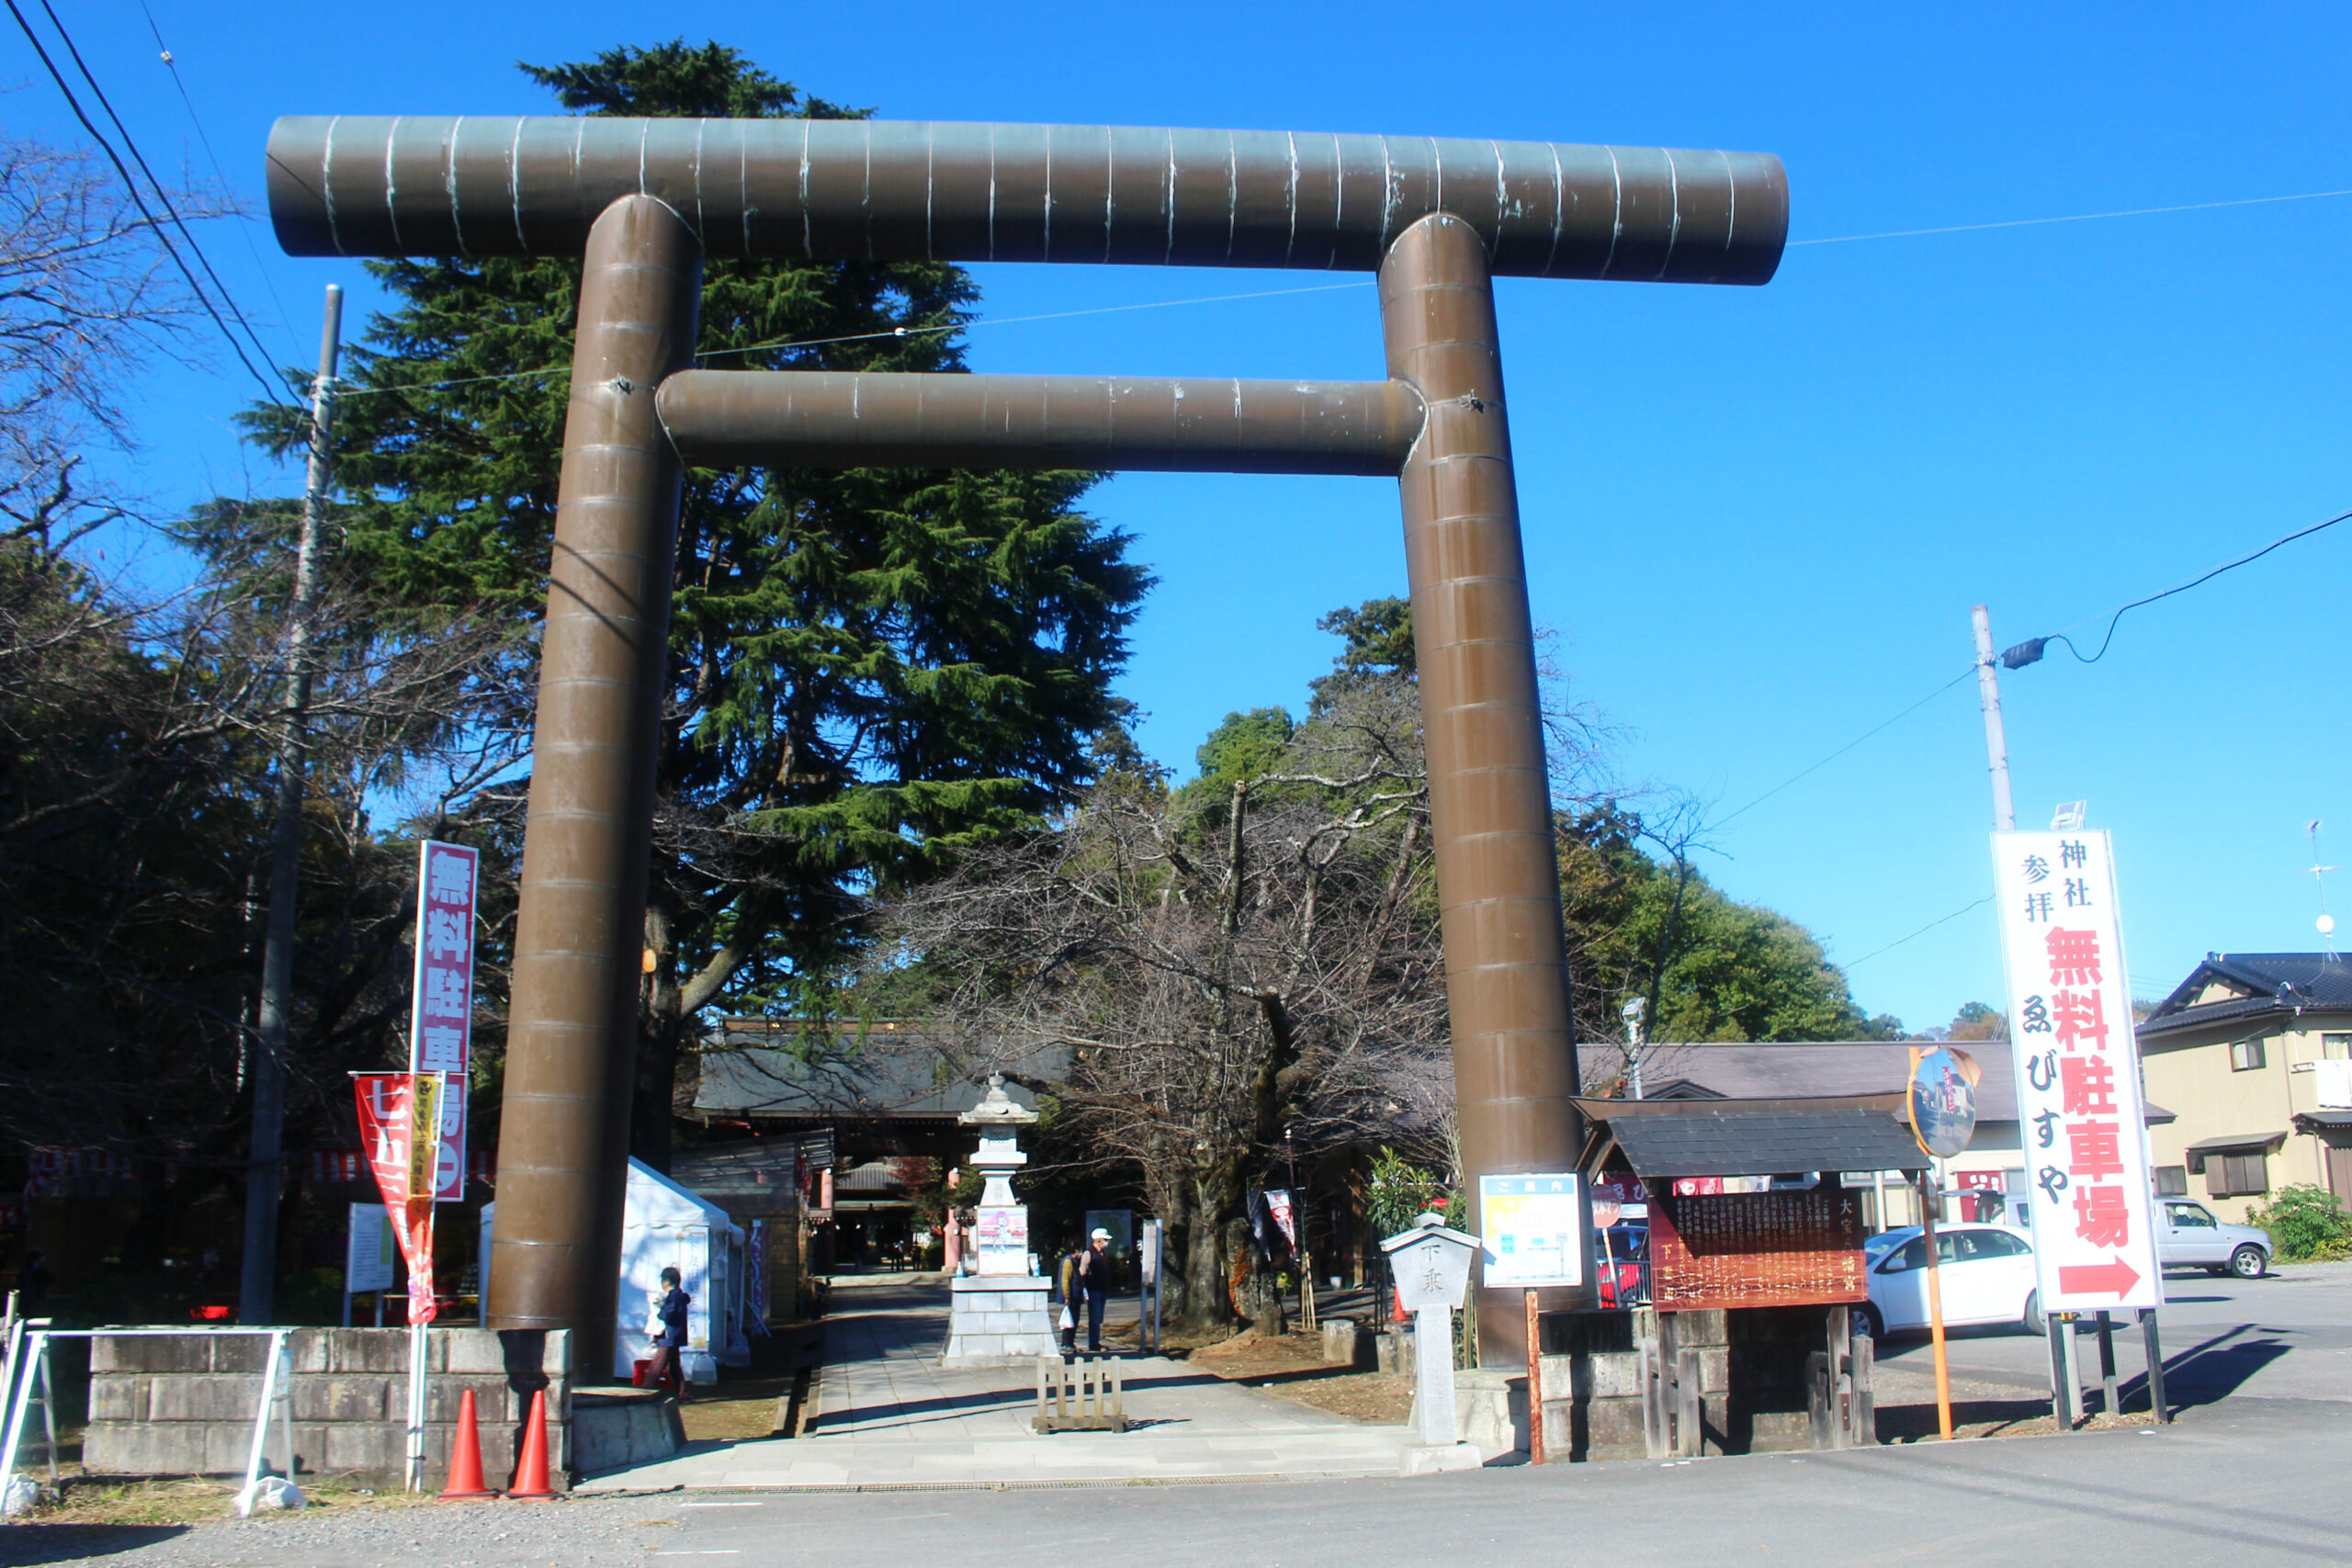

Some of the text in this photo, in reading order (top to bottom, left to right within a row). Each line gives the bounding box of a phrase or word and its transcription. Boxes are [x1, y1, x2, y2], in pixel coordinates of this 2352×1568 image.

[2021, 854, 2054, 922] 参拝
[2058, 840, 2093, 908] 神社
[421, 851, 472, 1138] 無料駐車場
[366, 1079, 409, 1206] 七五三
[2021, 995, 2069, 1205] ゑびすや
[2045, 925, 2131, 1250] 無料駐車場
[1420, 1244, 1444, 1293] 下乗
